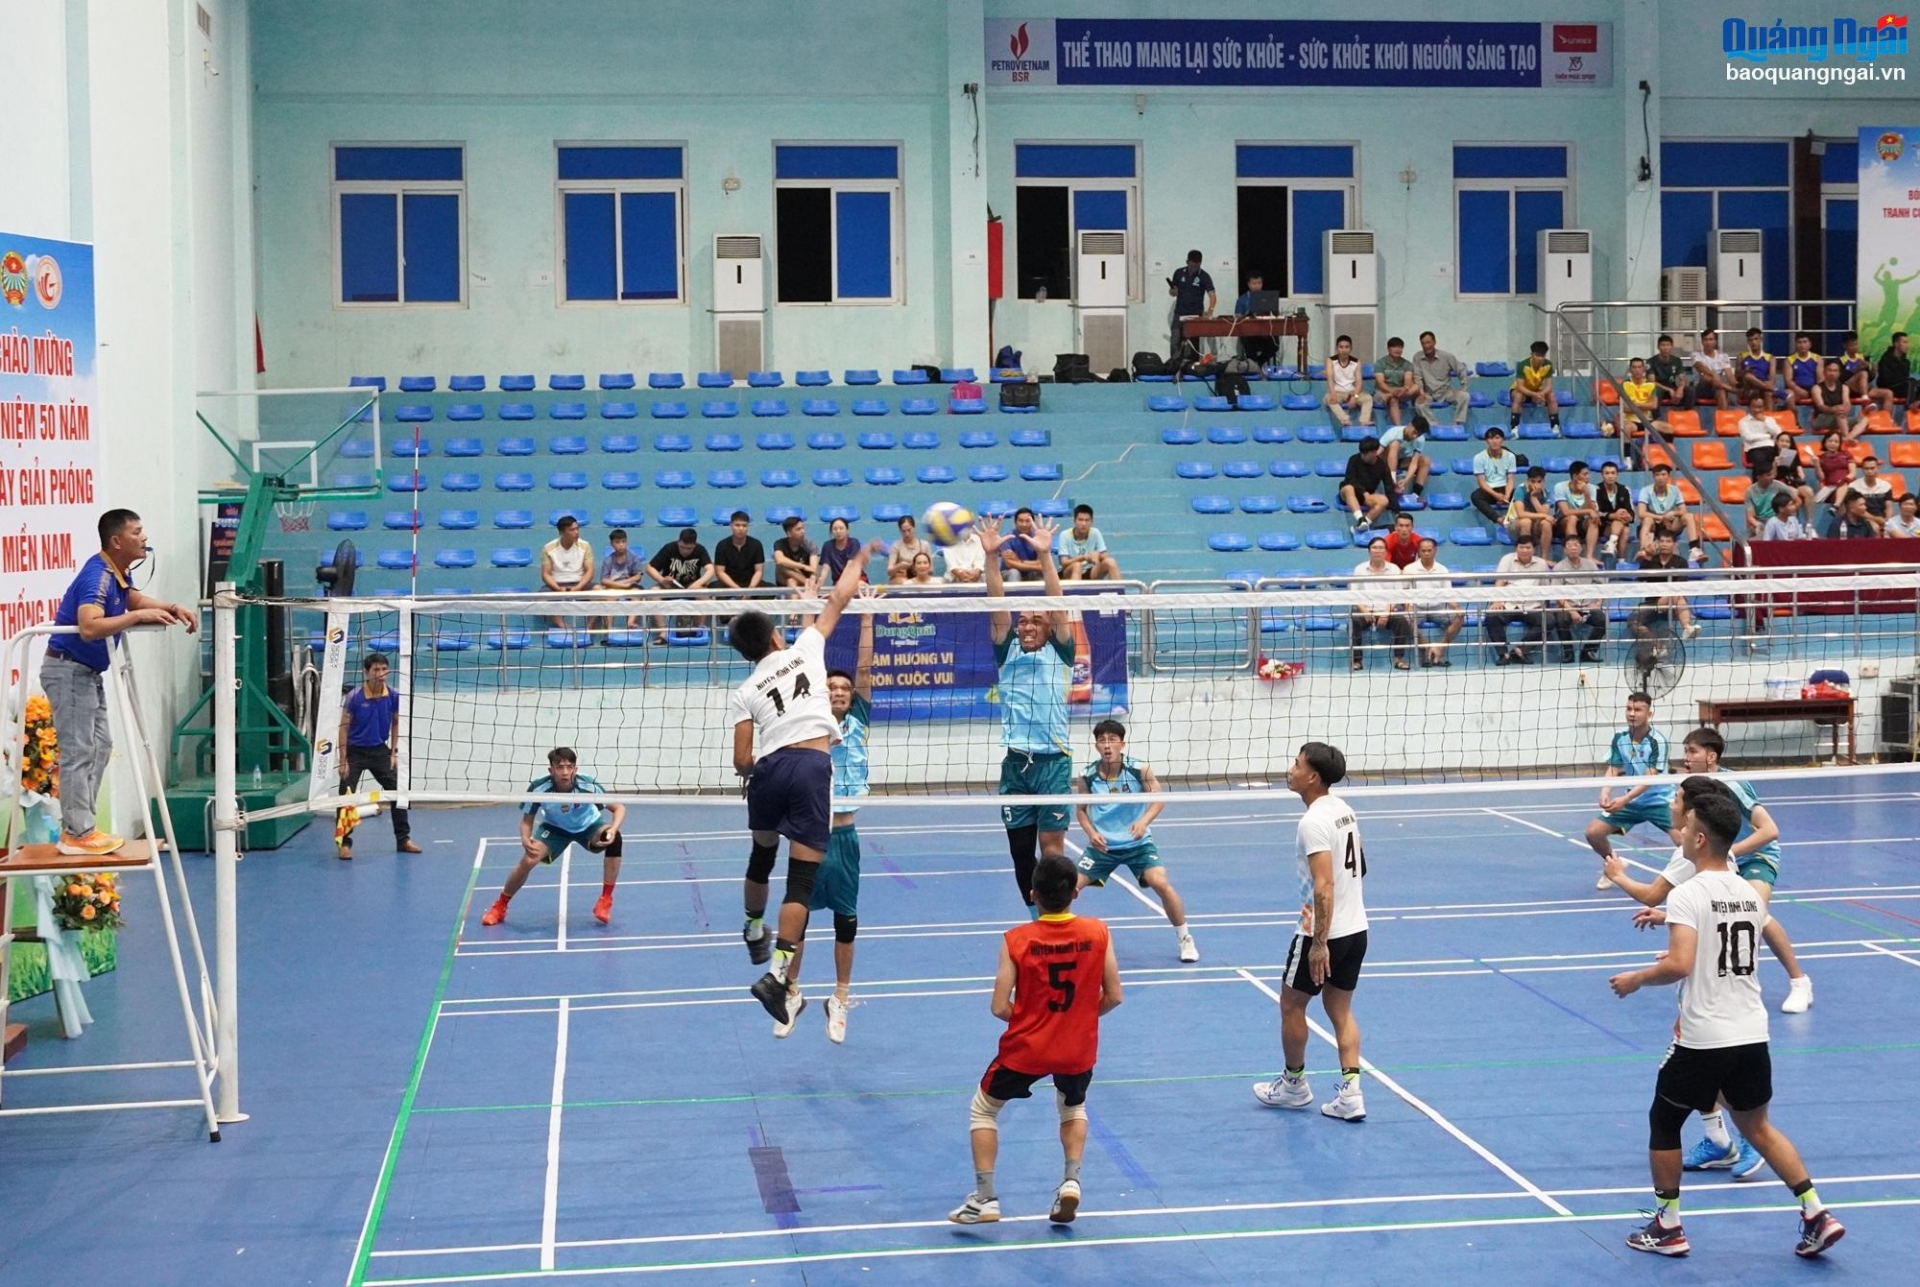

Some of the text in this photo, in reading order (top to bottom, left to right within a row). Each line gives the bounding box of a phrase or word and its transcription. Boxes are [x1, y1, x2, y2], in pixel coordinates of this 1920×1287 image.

[991, 60, 1050, 70] PETROVIETNAM
[1012, 71, 1030, 82] BSR
[1063, 31, 1091, 67] THỂ
[1094, 41, 1132, 68] THAO
[1136, 42, 1181, 68] MANG
[1186, 43, 1209, 74] LẠI
[1212, 37, 1242, 68] SỨC
[1246, 33, 1285, 68] KHỎE
[1299, 37, 1328, 69] SỨC
[1332, 34, 1370, 69] KHỎE
[1374, 41, 1408, 69] KHƠI
[1413, 35, 1462, 70] NGUỒN
[1467, 39, 1506, 70] SÁNG
[1509, 44, 1536, 76] TẠO
[1883, 207, 1910, 218] TRANH
[0, 327, 73, 377] HÀO MỪNG
[0, 395, 89, 448] NIỆM 50 NĂM
[20, 456, 46, 506] GIẢI
[50, 460, 94, 505] PHÓNG
[2, 522, 76, 573] MIỀN NAM,
[766, 672, 811, 718] 14
[934, 671, 954, 685] VUI
[1003, 806, 1013, 822] 5
[1344, 831, 1357, 878] 4
[1741, 900, 1758, 913] LONG
[1716, 920, 1756, 978] 10
[1047, 961, 1078, 1013] 5
